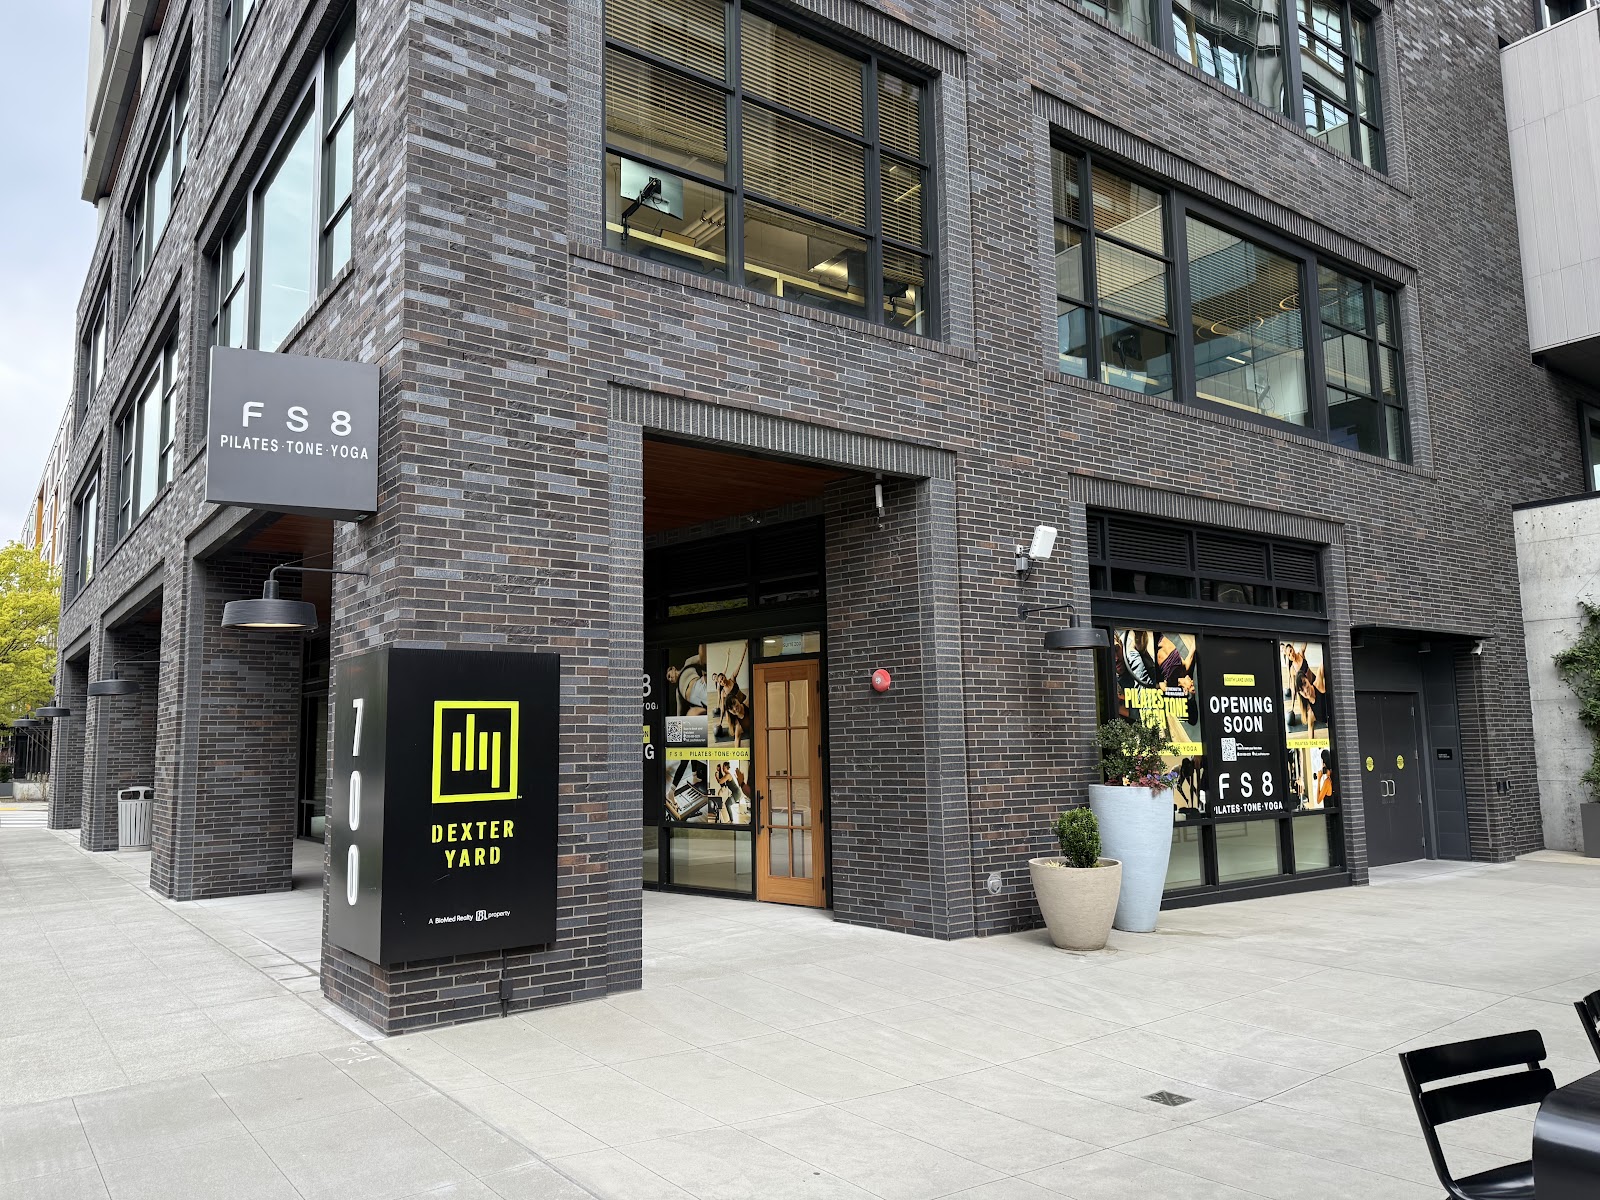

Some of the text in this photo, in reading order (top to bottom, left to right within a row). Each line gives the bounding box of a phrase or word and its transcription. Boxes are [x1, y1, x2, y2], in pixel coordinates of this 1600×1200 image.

[1124, 687, 1165, 709] PILATES
[1164, 697, 1189, 718] TONE
[1209, 695, 1273, 713] OPENING
[1223, 715, 1263, 733] SOON
[431, 819, 515, 844] DEXTER
[444, 846, 501, 869] YARD
[456, 914, 474, 922] Realty
[487, 910, 511, 920] property
